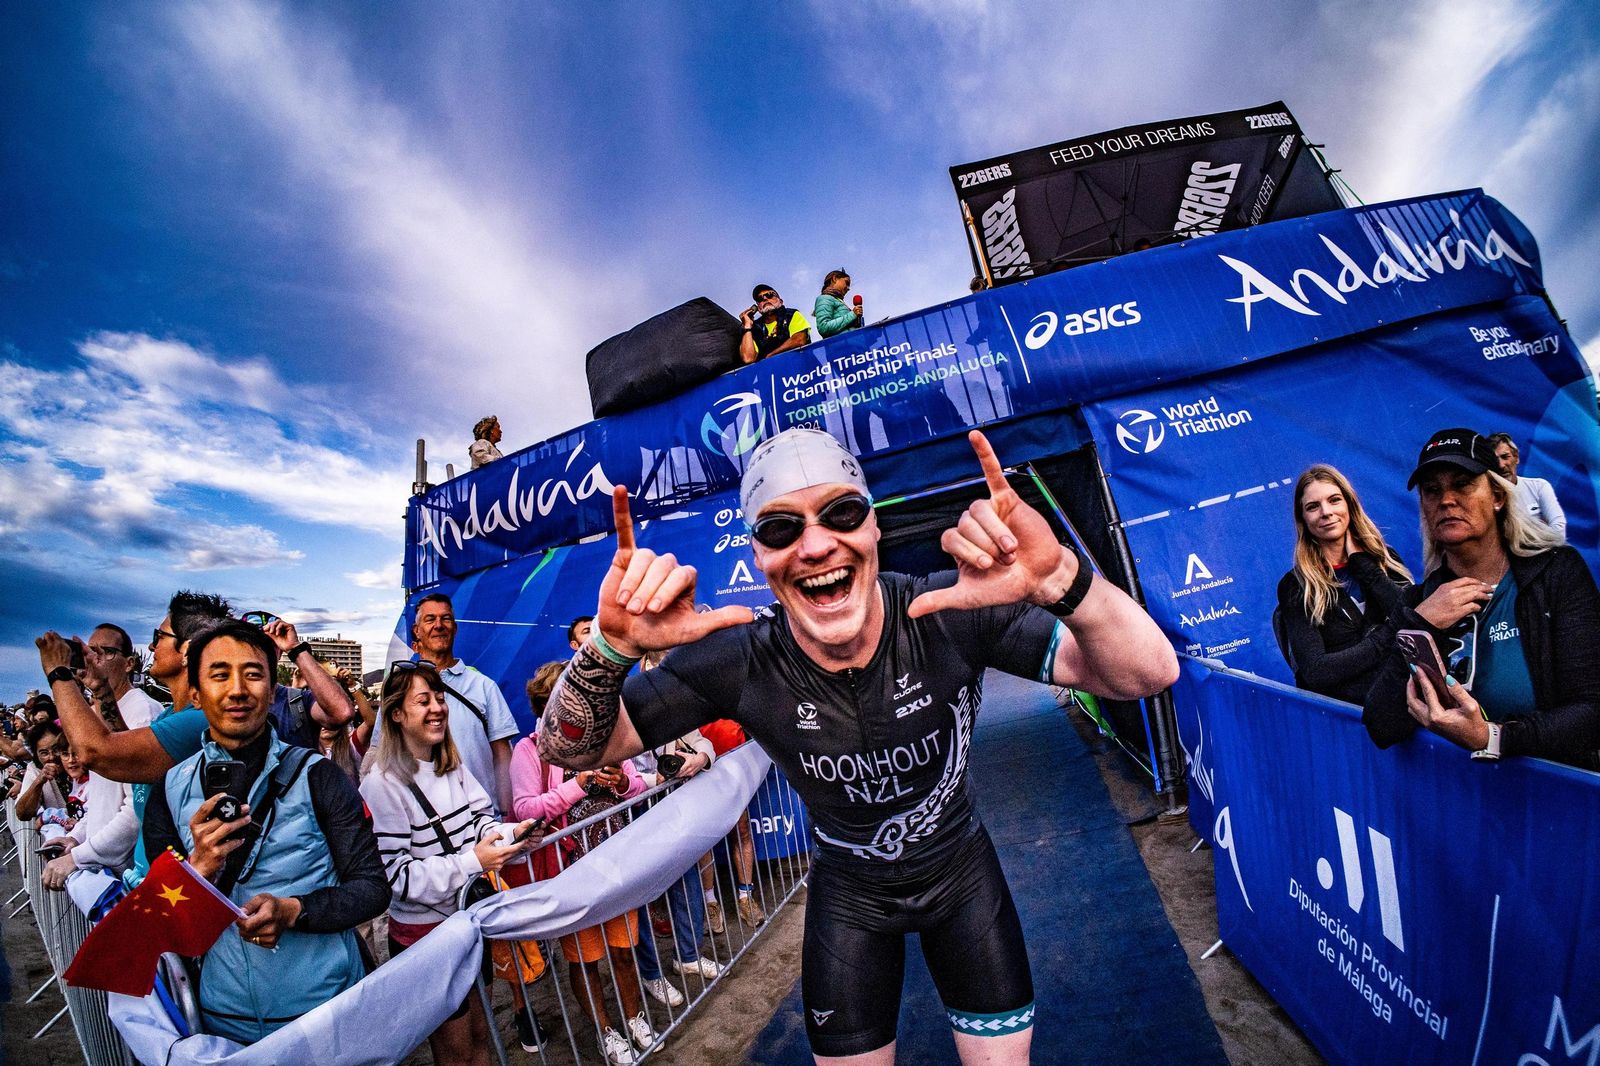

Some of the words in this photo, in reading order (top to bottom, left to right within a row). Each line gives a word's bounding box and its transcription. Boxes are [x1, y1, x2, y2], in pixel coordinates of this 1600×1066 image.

[1245, 112, 1293, 130] 226ERS
[1049, 143, 1094, 166] FEED
[1099, 134, 1144, 155] YOUR
[1146, 121, 1216, 146] DREAMS
[958, 163, 1012, 189] 226ERS
[1218, 208, 1532, 332] Andalucía
[1063, 301, 1141, 337] asics
[1469, 326, 1490, 342] Be
[782, 362, 832, 388] World
[834, 341, 912, 371] Triathlon
[782, 358, 903, 403] Championship
[904, 342, 958, 367] Finals
[785, 351, 1008, 424] TORREMOLINOS-ANDALUCÍA
[1161, 396, 1220, 421] World
[1168, 410, 1253, 437] Triathlon
[417, 440, 636, 567] Andalucía
[1171, 588, 1191, 599] Junta
[1191, 585, 1201, 593] de
[1201, 576, 1234, 591] Andalucía
[1179, 601, 1242, 629] Andalucía
[1489, 621, 1508, 635] AUS
[1205, 637, 1251, 654] Torremolinos
[893, 681, 923, 700] CUORE
[895, 694, 933, 719] 2XU
[799, 728, 940, 782] HOONHOUT
[844, 775, 914, 804] NZL
[1289, 877, 1358, 955] Diputación
[1361, 942, 1449, 1041] Provincial
[1317, 937, 1335, 964] de
[1338, 957, 1393, 1025] Málaga
